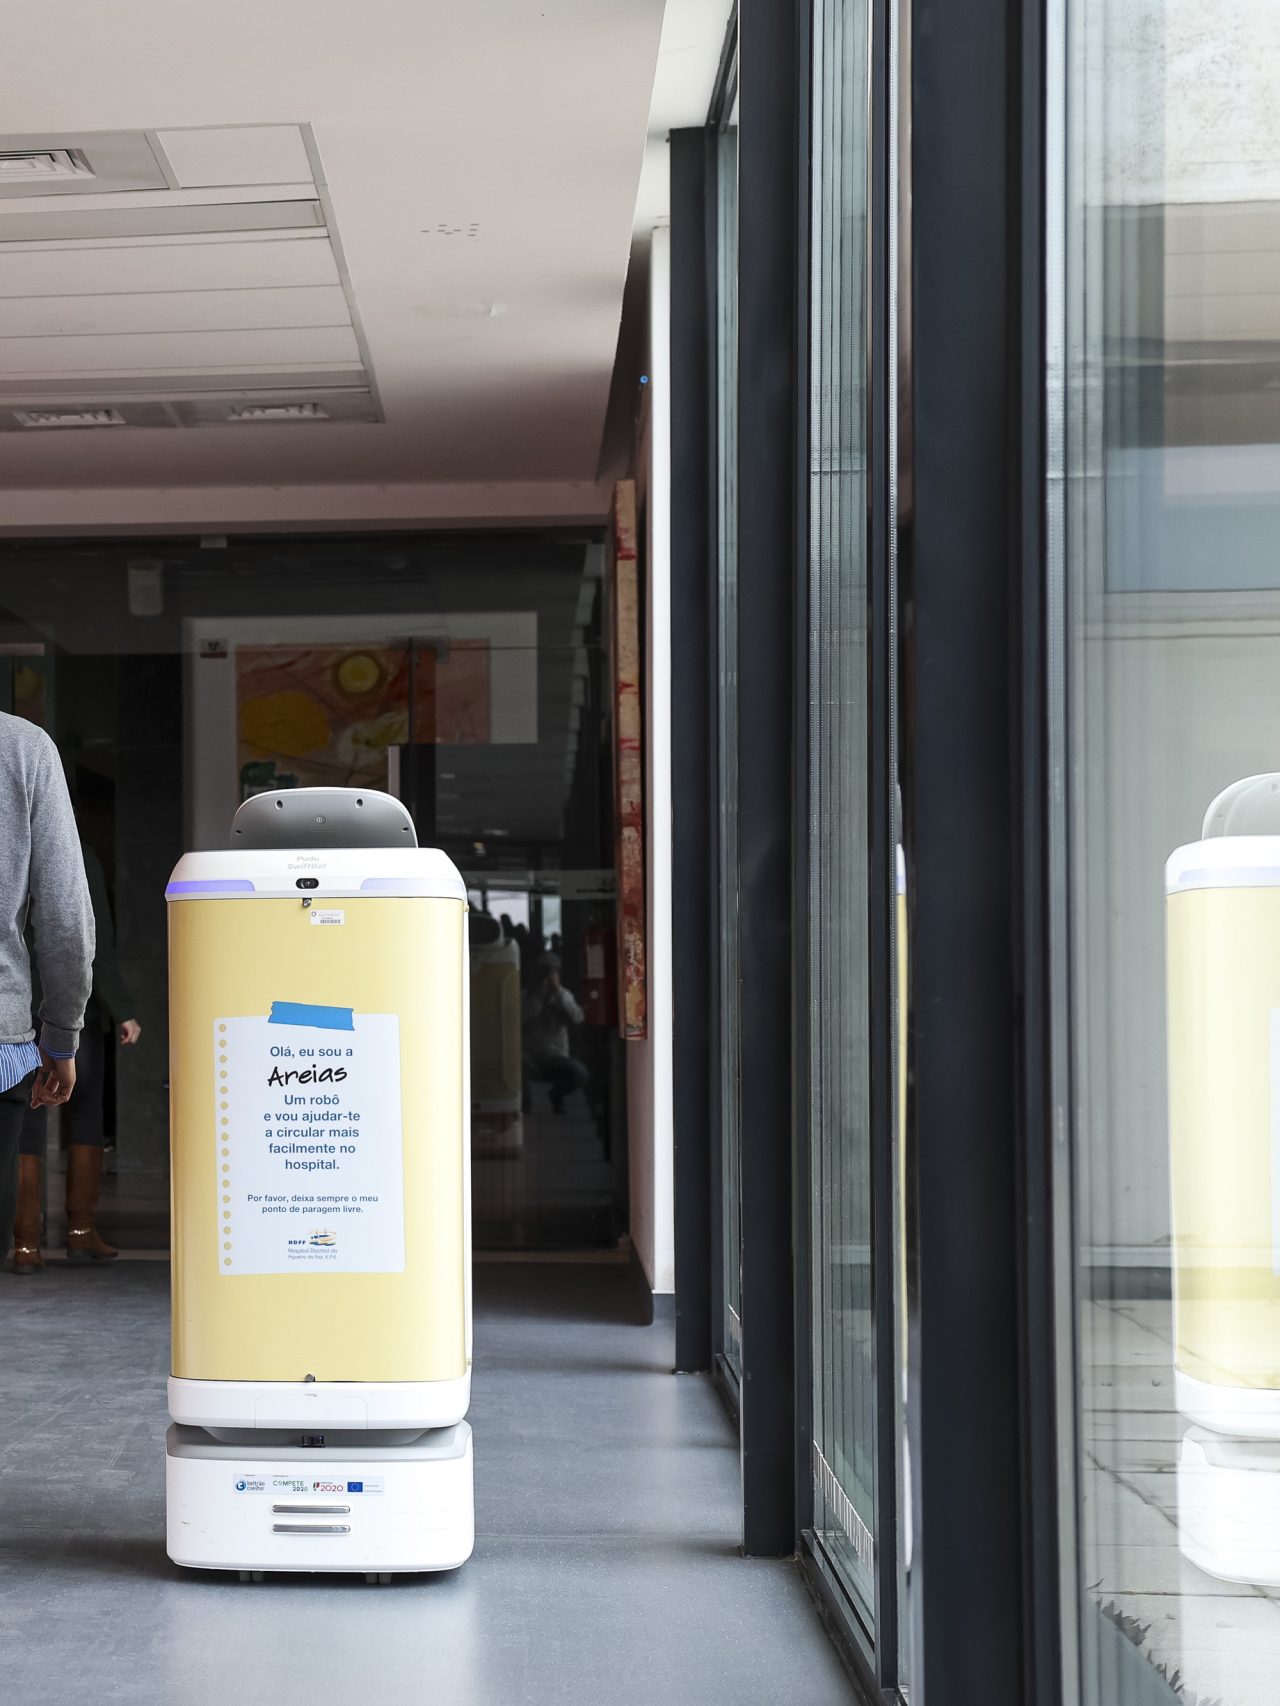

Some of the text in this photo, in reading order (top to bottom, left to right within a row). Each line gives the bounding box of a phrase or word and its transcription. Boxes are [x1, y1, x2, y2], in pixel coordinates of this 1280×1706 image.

[269, 1045, 354, 1059] Olá, eu sou a
[267, 1063, 348, 1087] Areias
[284, 1093, 340, 1106] Um robô
[263, 1110, 361, 1124] e vou ajudar-te
[265, 1126, 360, 1138] a circular mais
[269, 1142, 356, 1154] facilmente no
[284, 1158, 340, 1173] hospital.
[247, 1193, 379, 1204] Por favor, deixa sempre o meu
[261, 1204, 364, 1215] ponto de paragem livre.
